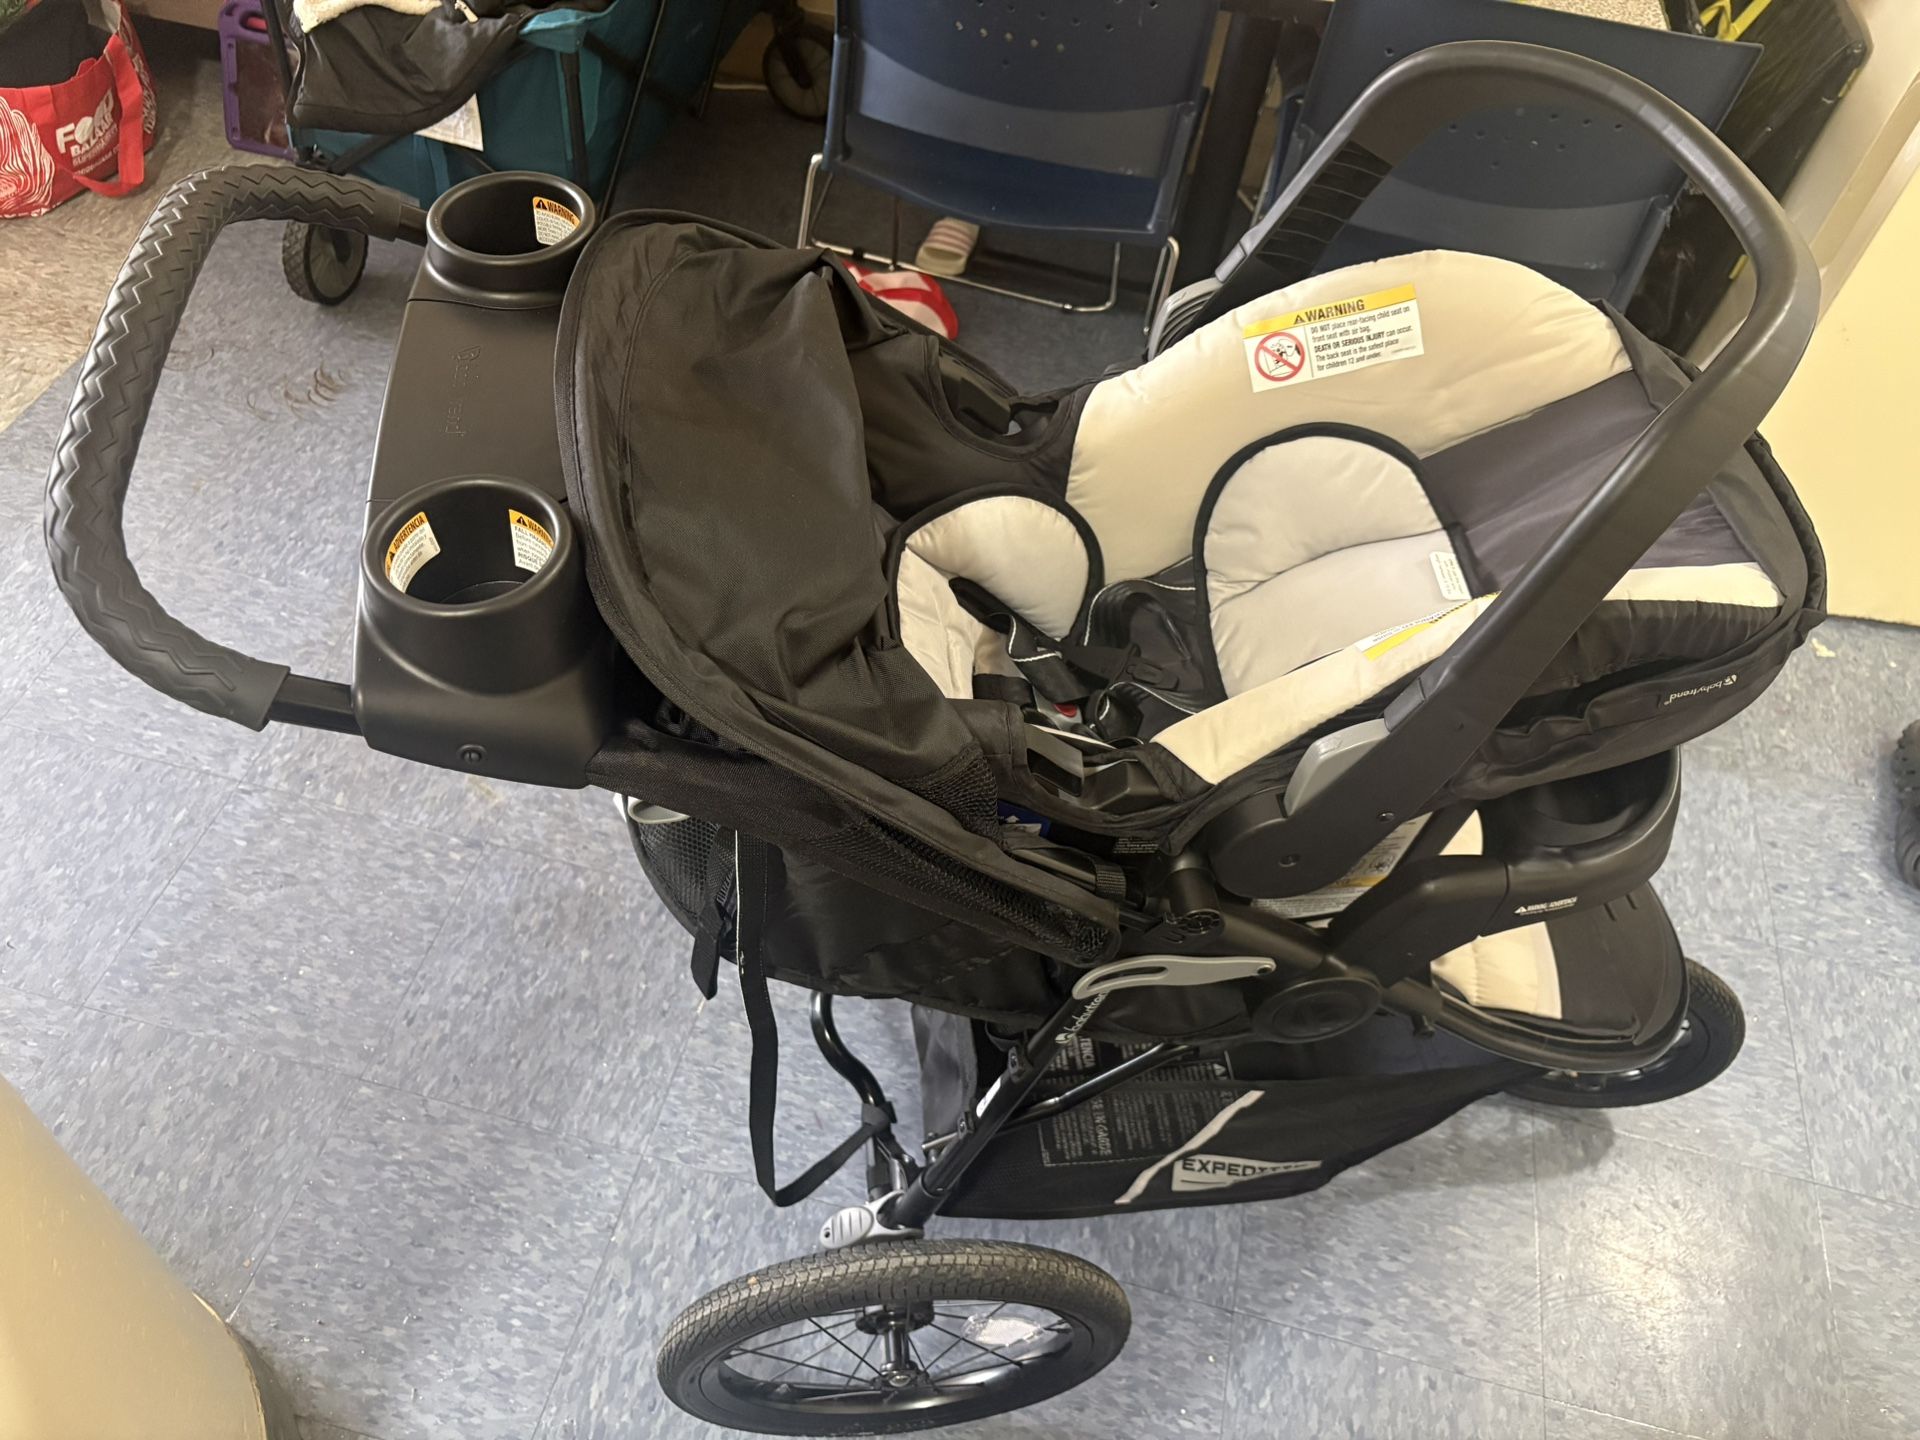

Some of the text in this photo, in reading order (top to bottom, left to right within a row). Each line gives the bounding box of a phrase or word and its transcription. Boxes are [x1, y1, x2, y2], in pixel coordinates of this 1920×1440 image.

[70, 111, 114, 158] BAZAAR
[1305, 299, 1365, 322] WARNING
[1320, 324, 1330, 332] NOT
[1331, 321, 1346, 330] place
[1347, 314, 1376, 327] rear-facing
[1377, 310, 1390, 319] child
[1391, 308, 1402, 316] seat
[1312, 333, 1325, 342] front
[1326, 331, 1338, 340] seat
[1339, 329, 1350, 337] with
[1351, 327, 1359, 335] air
[1314, 343, 1331, 353] DEATH
[1341, 336, 1365, 347] SERIOUS
[1366, 331, 1386, 342] INJURY
[1315, 354, 1326, 362] The
[1326, 351, 1339, 360] back
[1340, 348, 1352, 357] seat
[1352, 347, 1358, 355] is
[1359, 345, 1367, 353] the
[1368, 342, 1384, 352] safest
[1384, 338, 1399, 348] place
[1317, 363, 1325, 371] for
[1325, 359, 1347, 370] children
[1355, 355, 1365, 363] and
[393, 515, 425, 550] ADVERTENCIA
[1669, 680, 1722, 703] babytrend
[1063, 992, 1109, 1033] babytre
[1080, 1038, 1096, 1068] TENCIA
